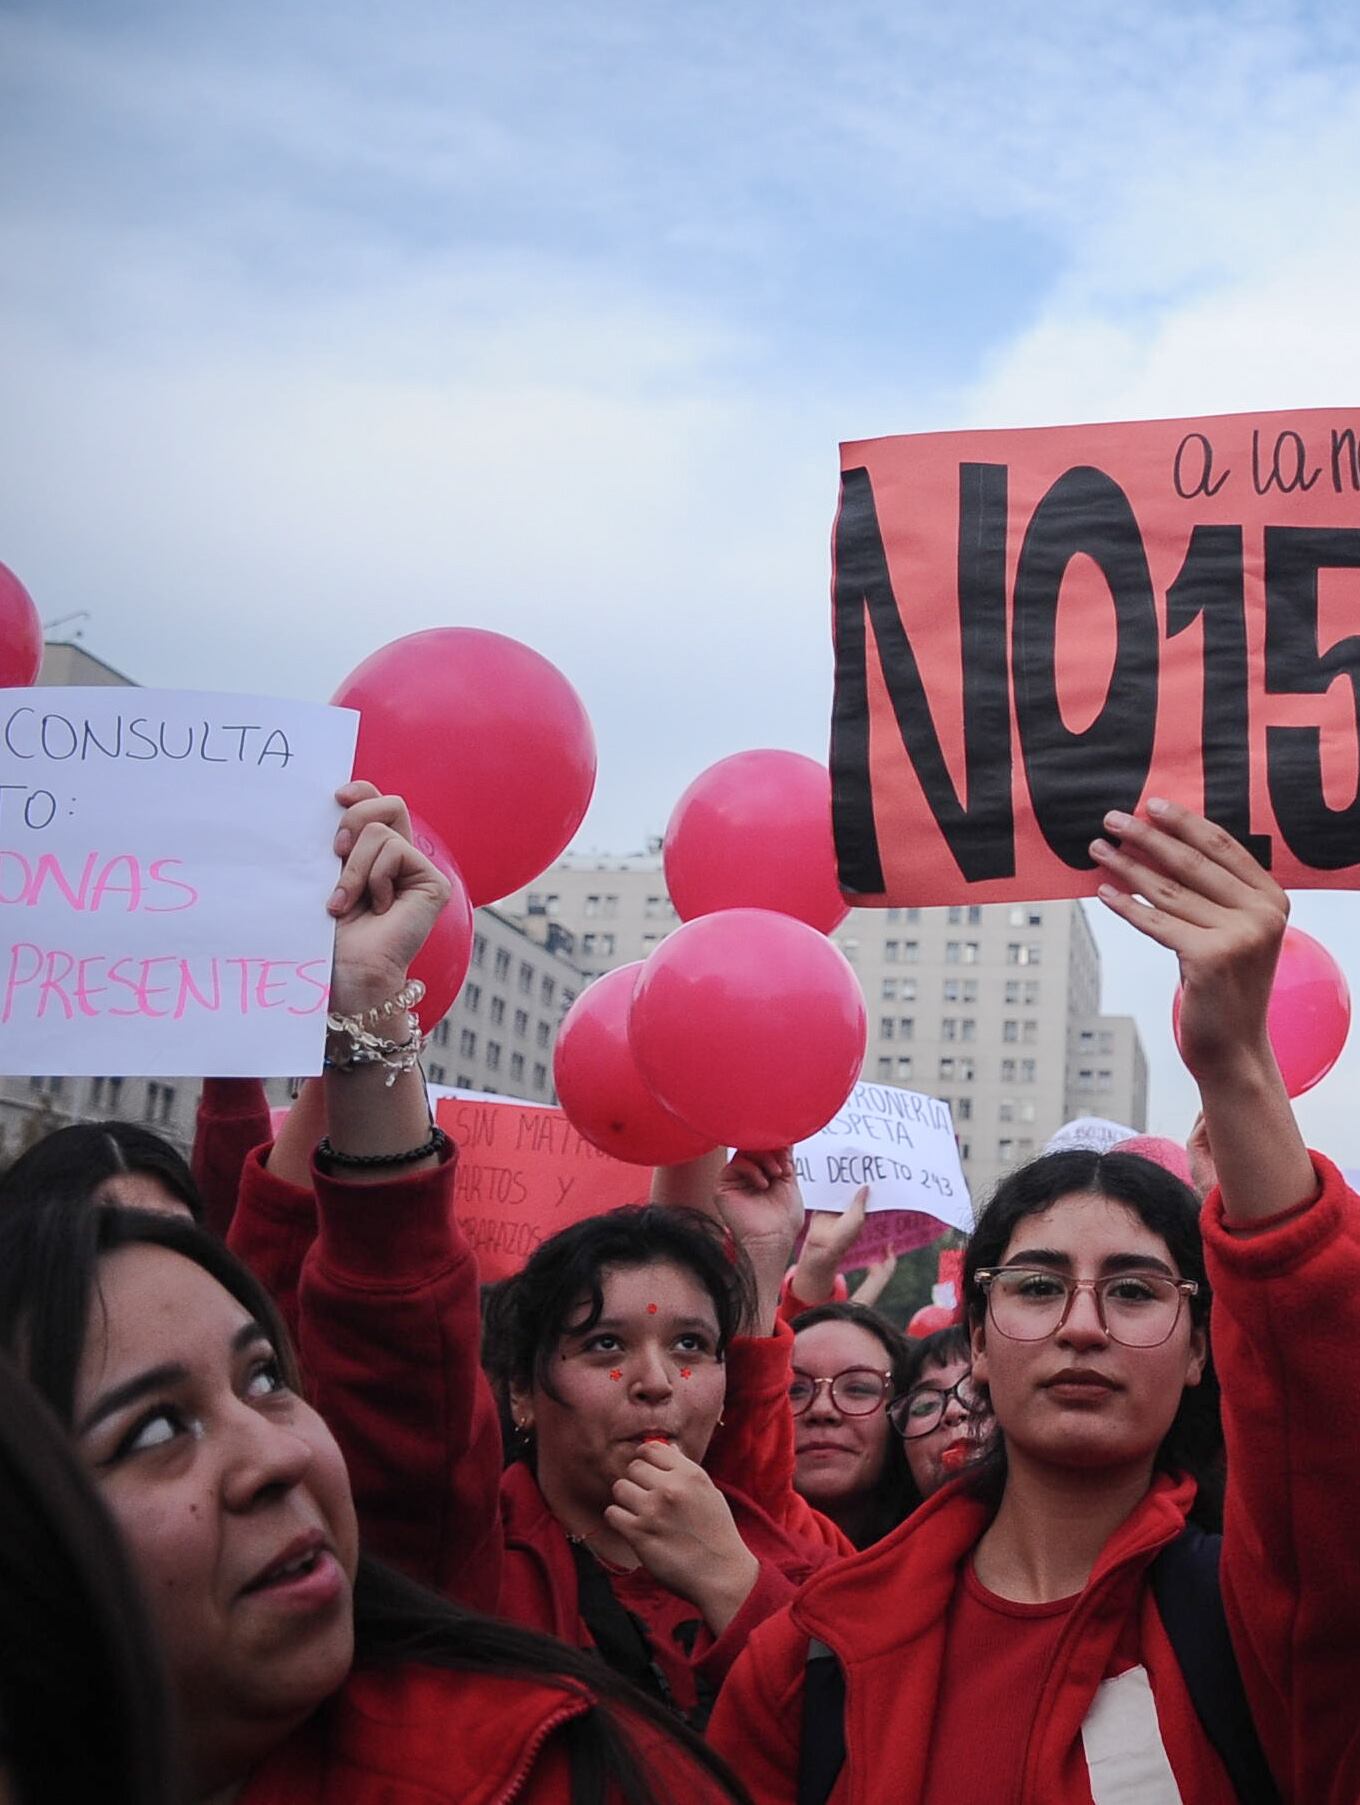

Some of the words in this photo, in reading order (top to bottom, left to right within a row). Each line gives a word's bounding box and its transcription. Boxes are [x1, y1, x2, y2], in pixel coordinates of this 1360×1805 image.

[1173, 432, 1231, 499] a
[1252, 428, 1322, 496] la
[5, 707, 295, 768] CONSULTA
[2, 943, 331, 1023] PRESENTES
[456, 1106, 498, 1148] SIN
[826, 1154, 912, 1185] DECRETO
[919, 1169, 954, 1197] 243
